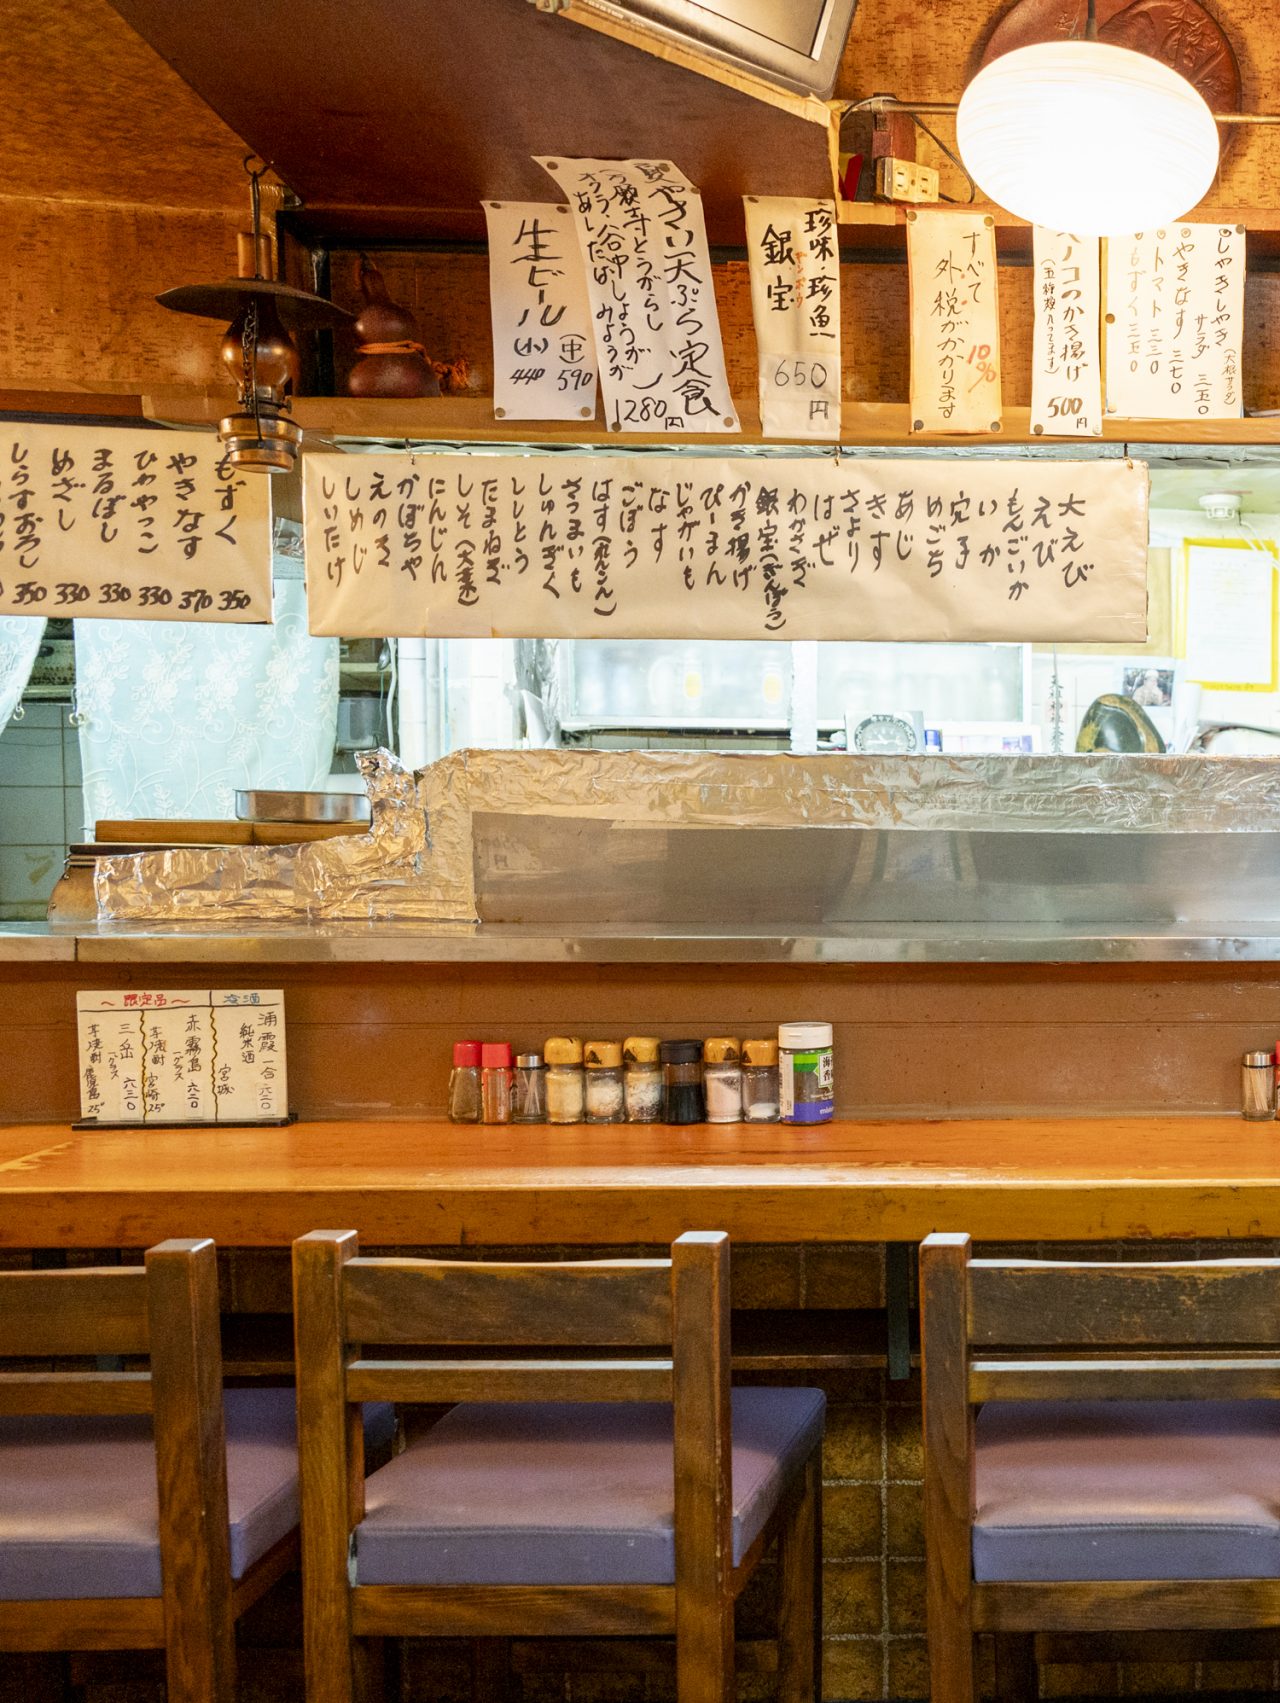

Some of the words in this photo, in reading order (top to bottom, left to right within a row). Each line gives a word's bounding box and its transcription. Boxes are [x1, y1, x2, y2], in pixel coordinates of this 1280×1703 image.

[510, 218, 567, 327] 生ビール
[634, 163, 720, 415] 夏やさい天ぷら定食
[760, 224, 796, 311] 銀宝
[963, 232, 984, 303] すべて
[1056, 232, 1088, 382] ノコのかき揚げ
[930, 250, 969, 419] 外税がかかります
[557, 369, 593, 391] 590
[612, 397, 684, 430] 1280円
[8, 442, 43, 569] しらすおろし
[51, 447, 86, 531] めざし
[166, 452, 205, 560] やきなす
[321, 476, 345, 588] しいたけ
[345, 476, 369, 575] しめじ
[369, 472, 392, 568] えのき
[428, 477, 449, 584] にんじん
[482, 478, 510, 585] たまねぎ
[511, 477, 529, 575] ししとう
[620, 482, 644, 568] ごぼう
[648, 488, 670, 563] なす
[813, 494, 840, 566] はぜ
[840, 488, 861, 573] さより
[894, 491, 914, 561] あじ
[951, 491, 971, 570] 穴子
[1032, 496, 1058, 567] えび
[539, 473, 564, 599] しゅんぎく
[561, 477, 584, 593] さつまいも
[725, 481, 757, 591] かき揚げ
[787, 488, 815, 588] わかさぎ
[865, 493, 890, 573] きす
[926, 495, 947, 577] めごち
[978, 499, 1000, 567] いか
[1003, 488, 1029, 601] もんごいか
[1058, 493, 1094, 588] 大えび
[12, 581, 47, 605] 350
[54, 583, 90, 605] 330
[98, 583, 132, 604] 330
[138, 586, 173, 606] 330
[178, 590, 213, 613] 370
[218, 590, 251, 611] 350
